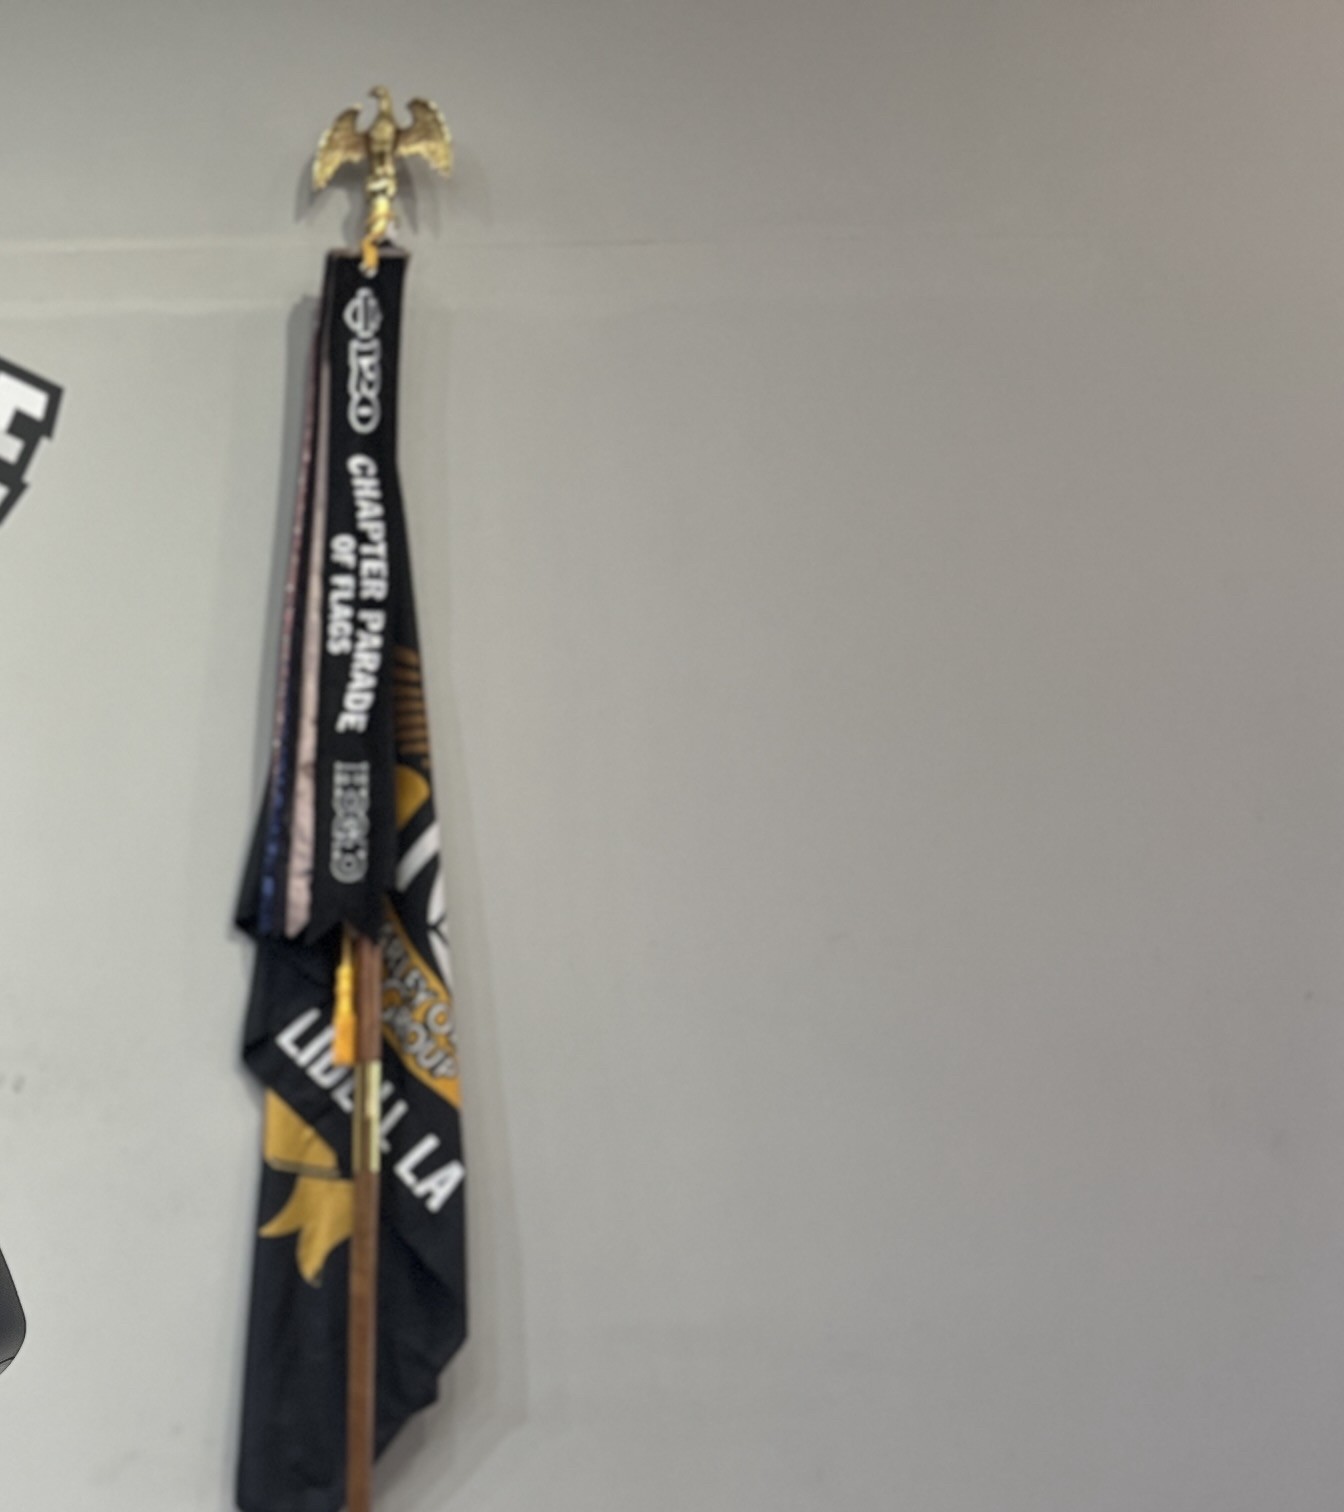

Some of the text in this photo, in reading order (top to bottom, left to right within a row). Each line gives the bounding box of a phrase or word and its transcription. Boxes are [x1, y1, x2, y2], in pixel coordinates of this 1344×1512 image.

[346, 453, 389, 601] CHAPTER
[326, 533, 357, 656] OF FLAGS
[336, 608, 387, 734] PARADE
[394, 1134, 467, 1213] LA
